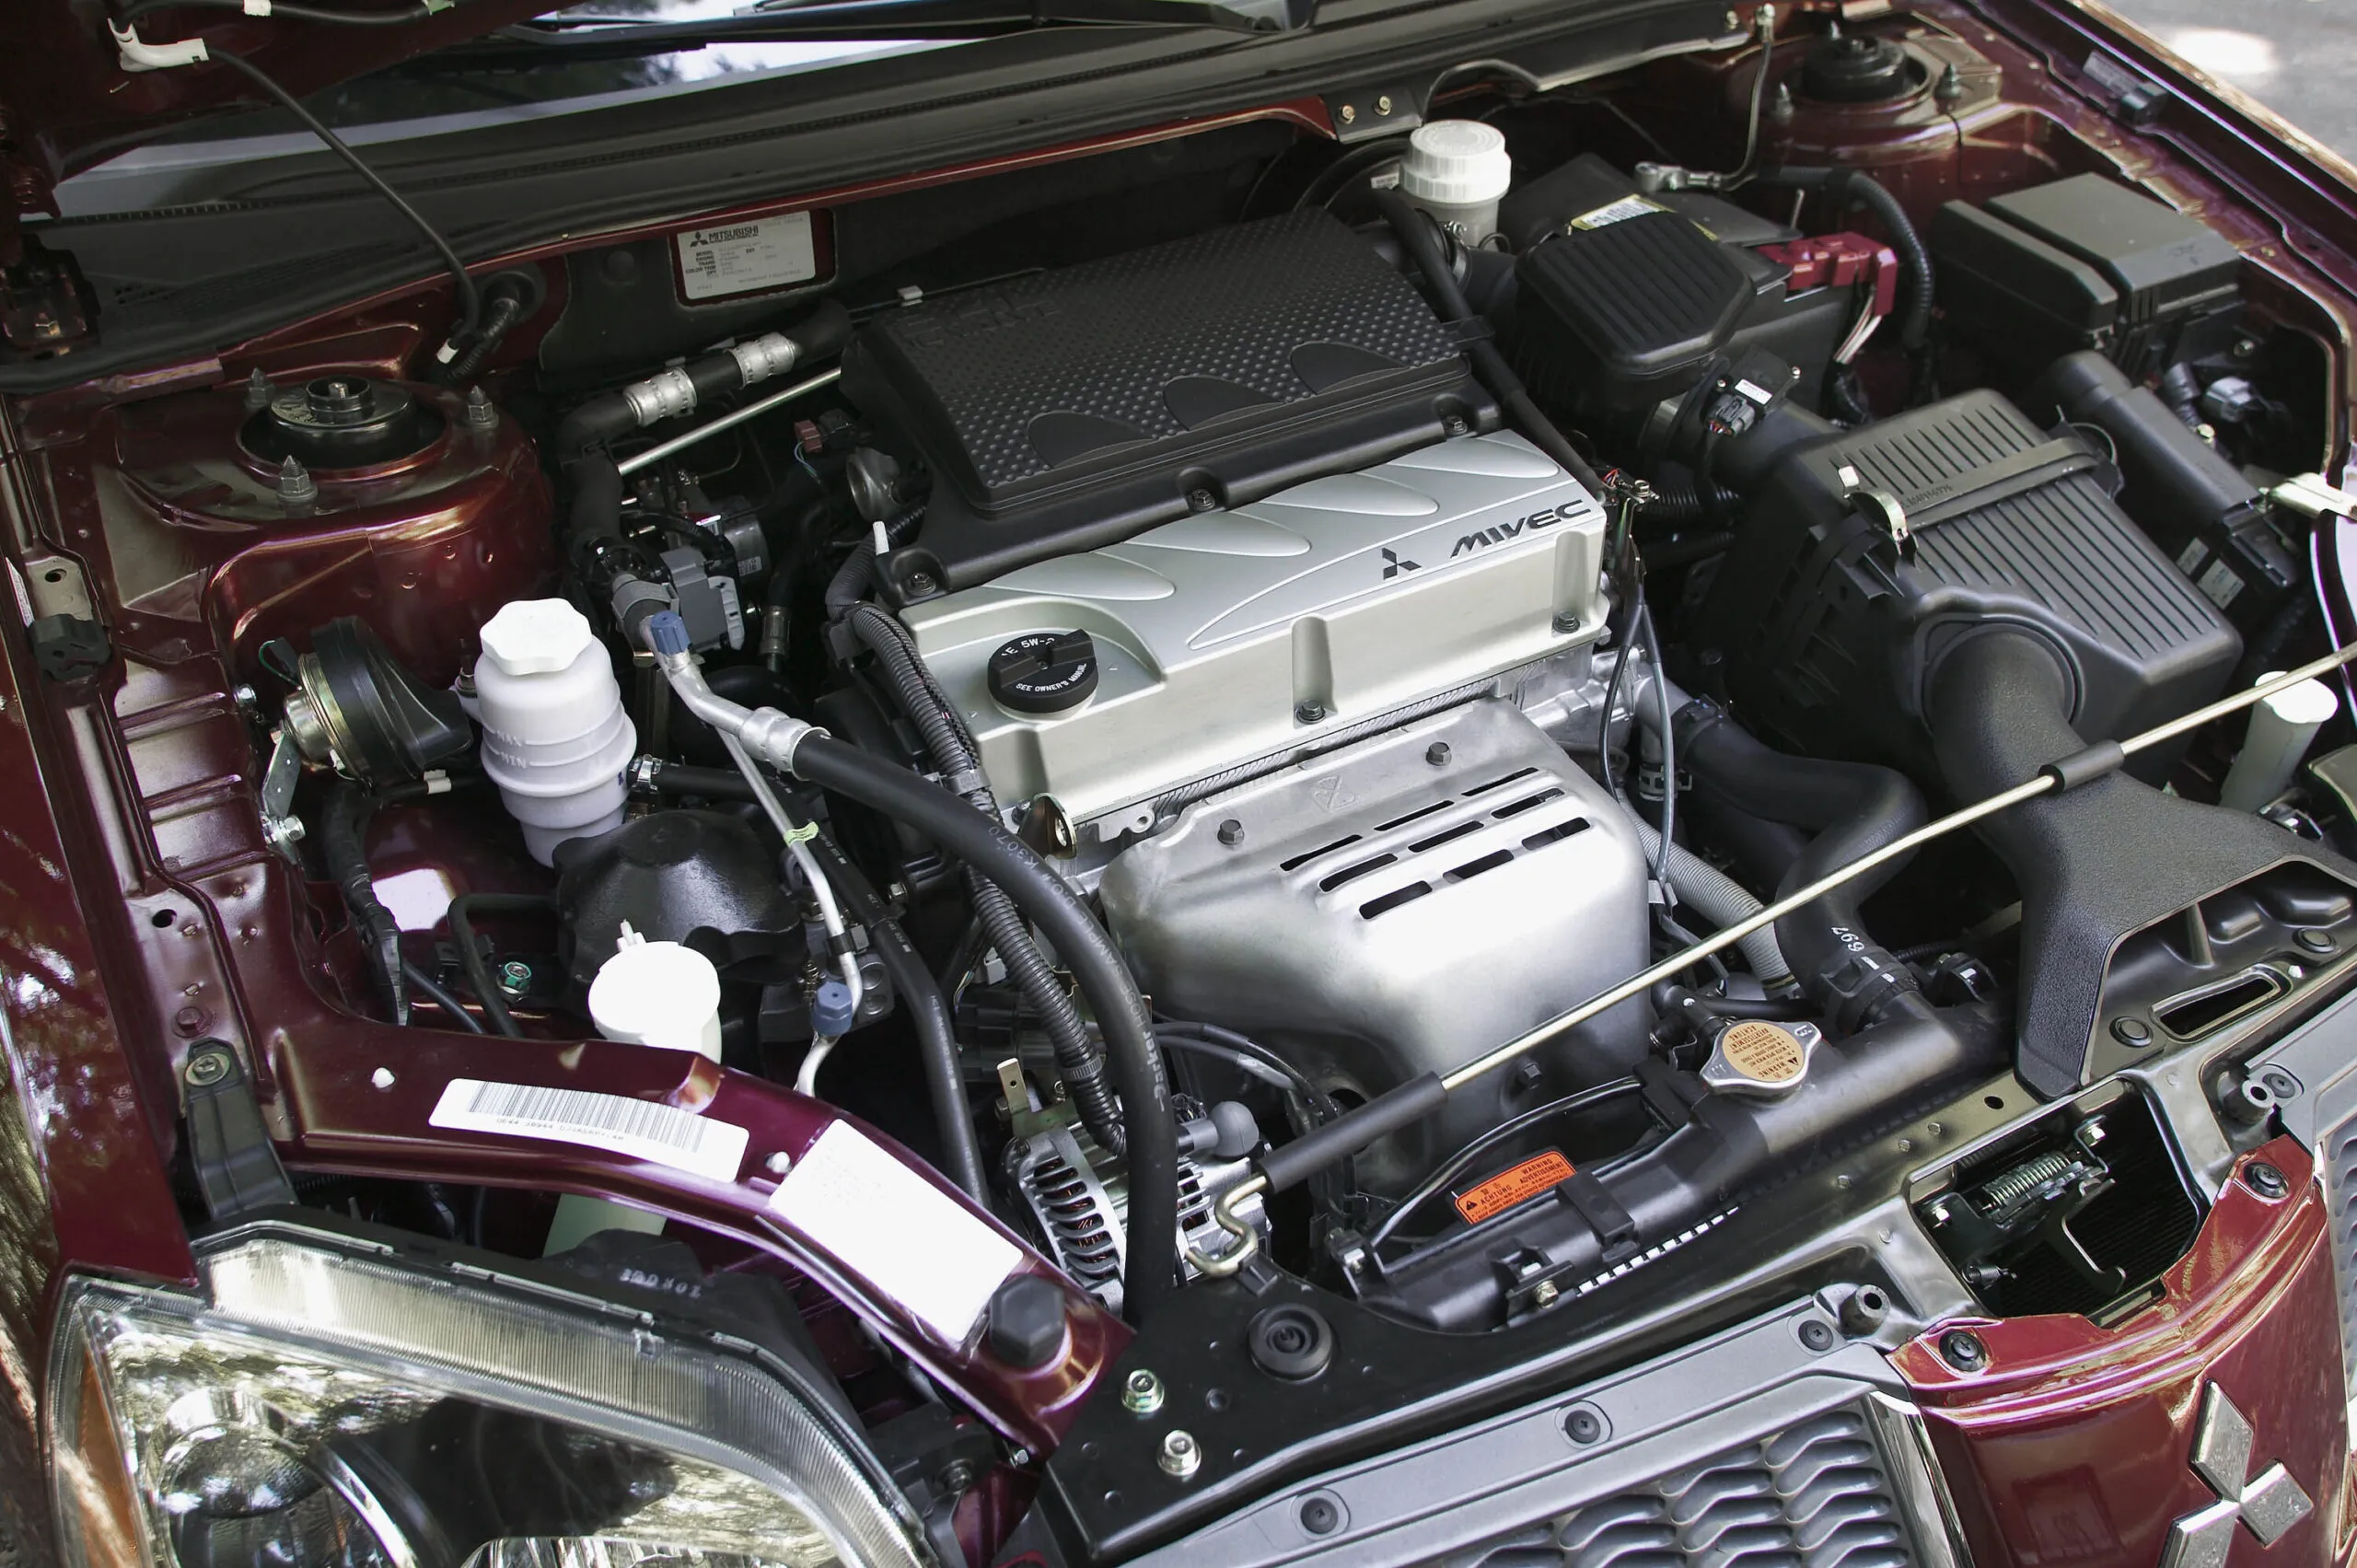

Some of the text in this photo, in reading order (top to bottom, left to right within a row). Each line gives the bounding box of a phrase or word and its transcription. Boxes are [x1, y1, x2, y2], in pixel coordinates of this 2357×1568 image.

[709, 225, 759, 241] MITSUBISHI
[1450, 499, 1591, 559] MIVEC
[1016, 663, 1087, 692] SEE OWNER'S MANUAL
[496, 730, 523, 748] MAX
[500, 751, 528, 770] MIN
[989, 826, 1039, 870] K3070
[1758, 1061, 1787, 1078] WARNING
[1521, 1157, 1553, 1175] WARNING
[1480, 1184, 1513, 1205] ACHTUNG
